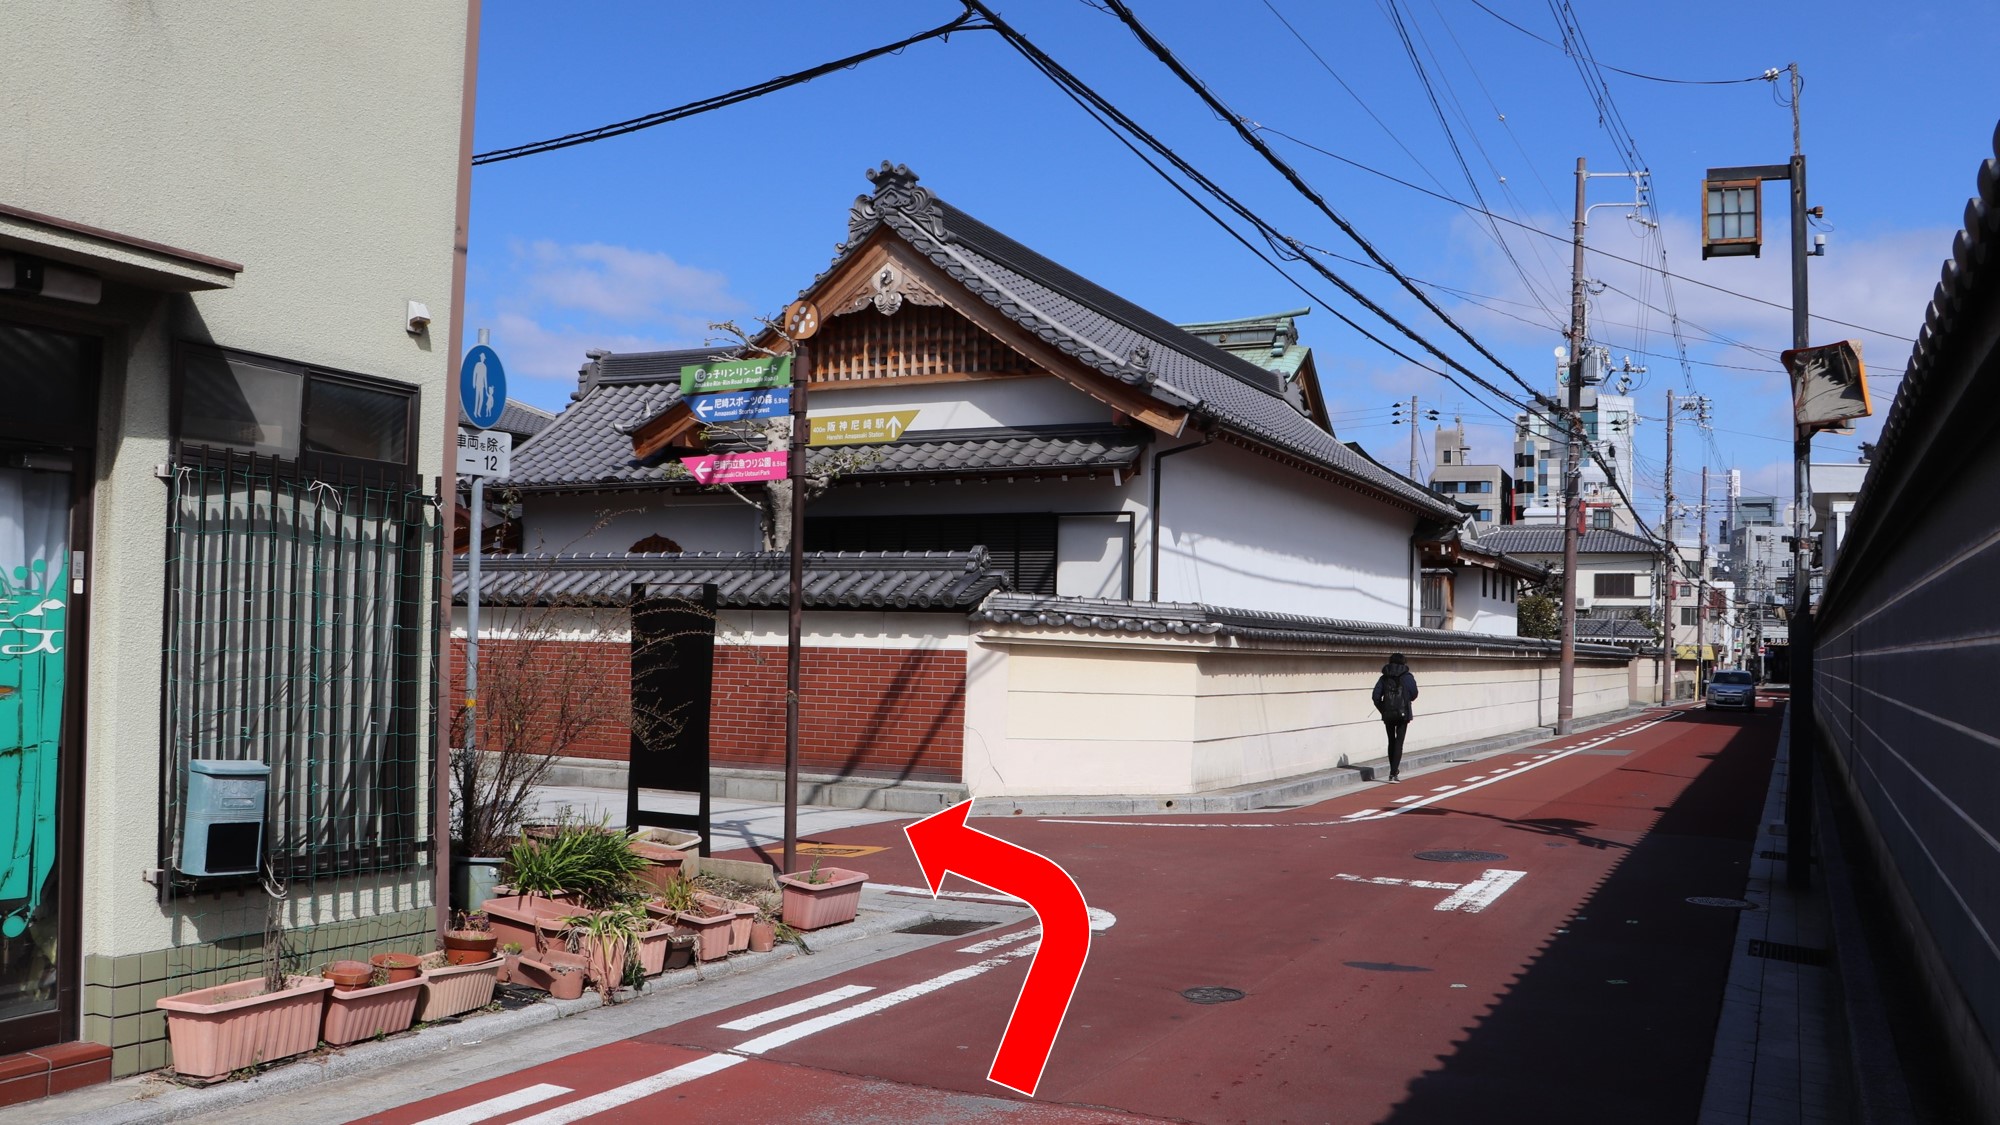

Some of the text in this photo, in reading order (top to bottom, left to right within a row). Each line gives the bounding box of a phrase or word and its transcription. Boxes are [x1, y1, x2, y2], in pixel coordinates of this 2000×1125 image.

[714, 394, 773, 410] 尼崎スポーツの森
[827, 418, 885, 432] 阪神尼崎駅
[713, 457, 772, 471] 尼崎市立魚つり公園
